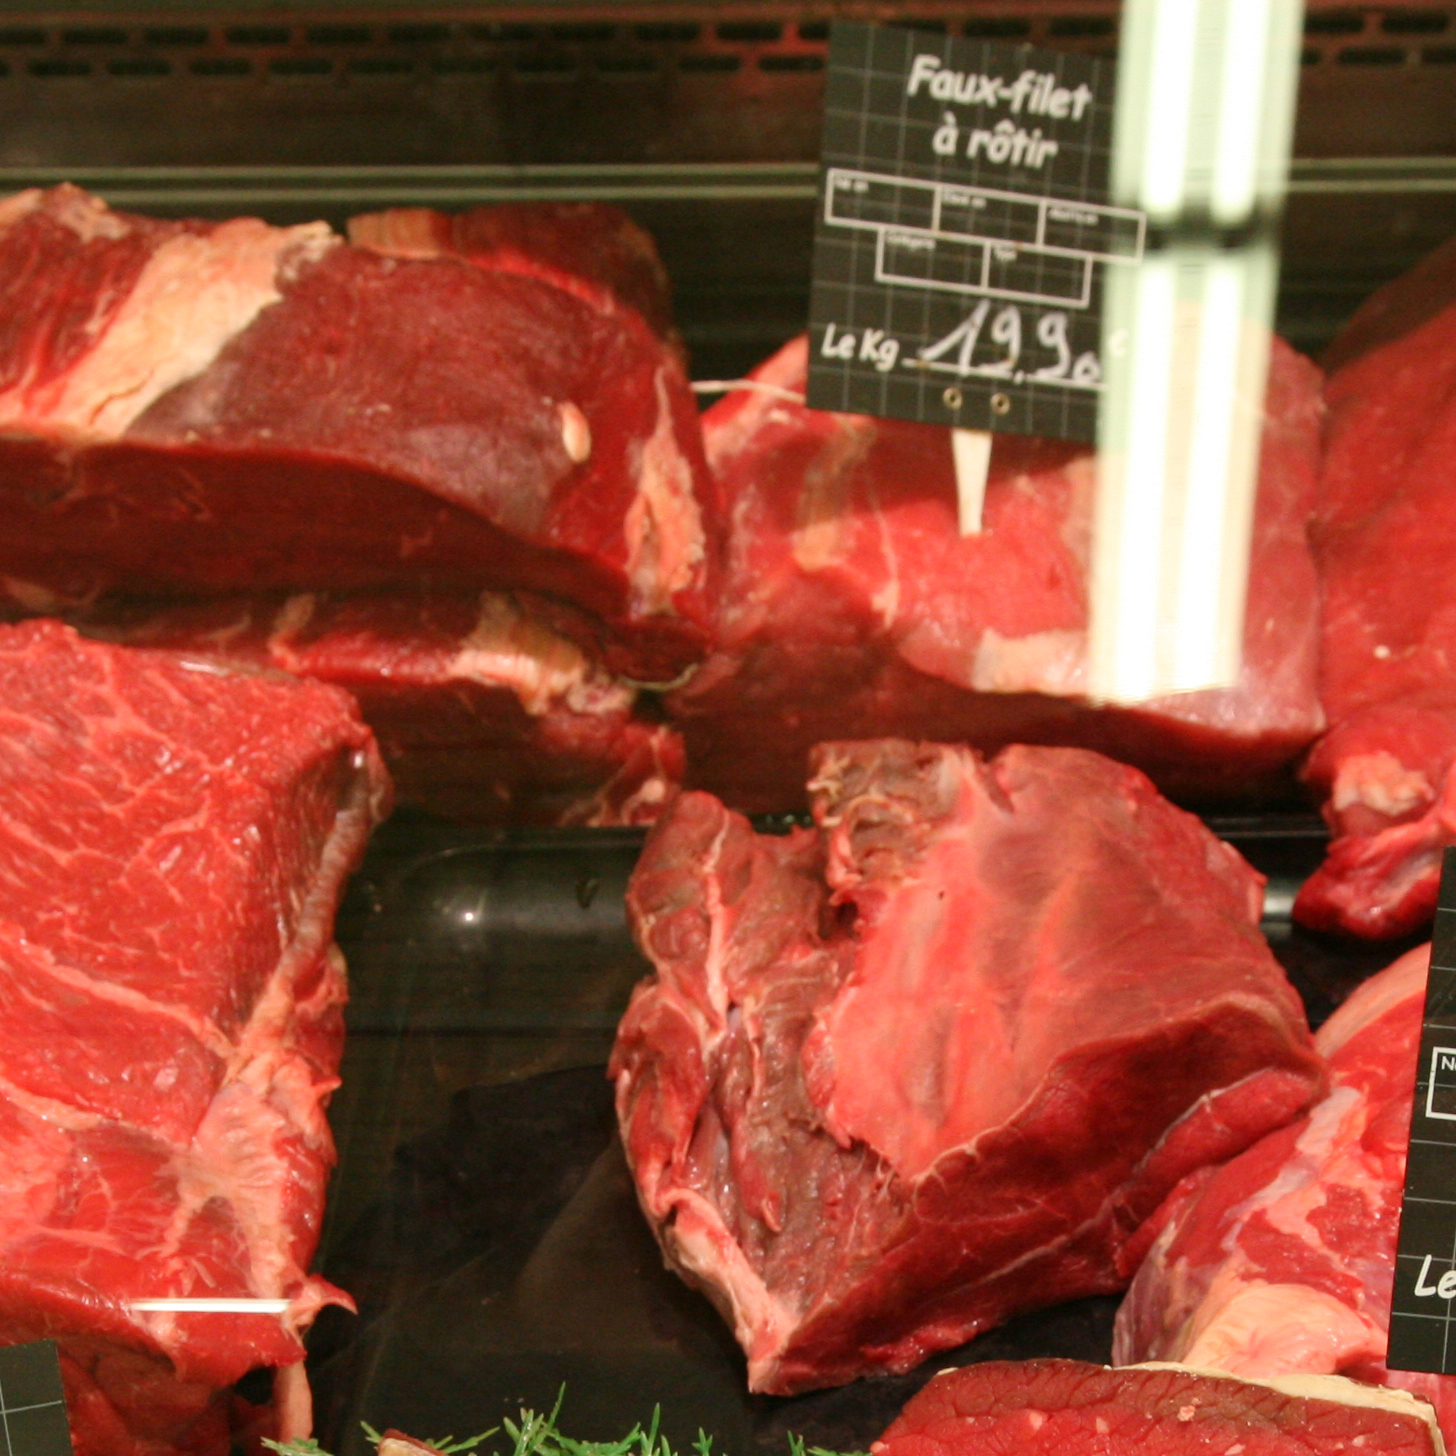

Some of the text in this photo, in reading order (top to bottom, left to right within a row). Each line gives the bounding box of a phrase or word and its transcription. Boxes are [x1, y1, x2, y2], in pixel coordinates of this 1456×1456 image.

[907, 54, 1093, 121] Faux-filet
[932, 111, 1059, 169] à rôtir
[821, 322, 856, 358] Le
[860, 328, 899, 372] Kg
